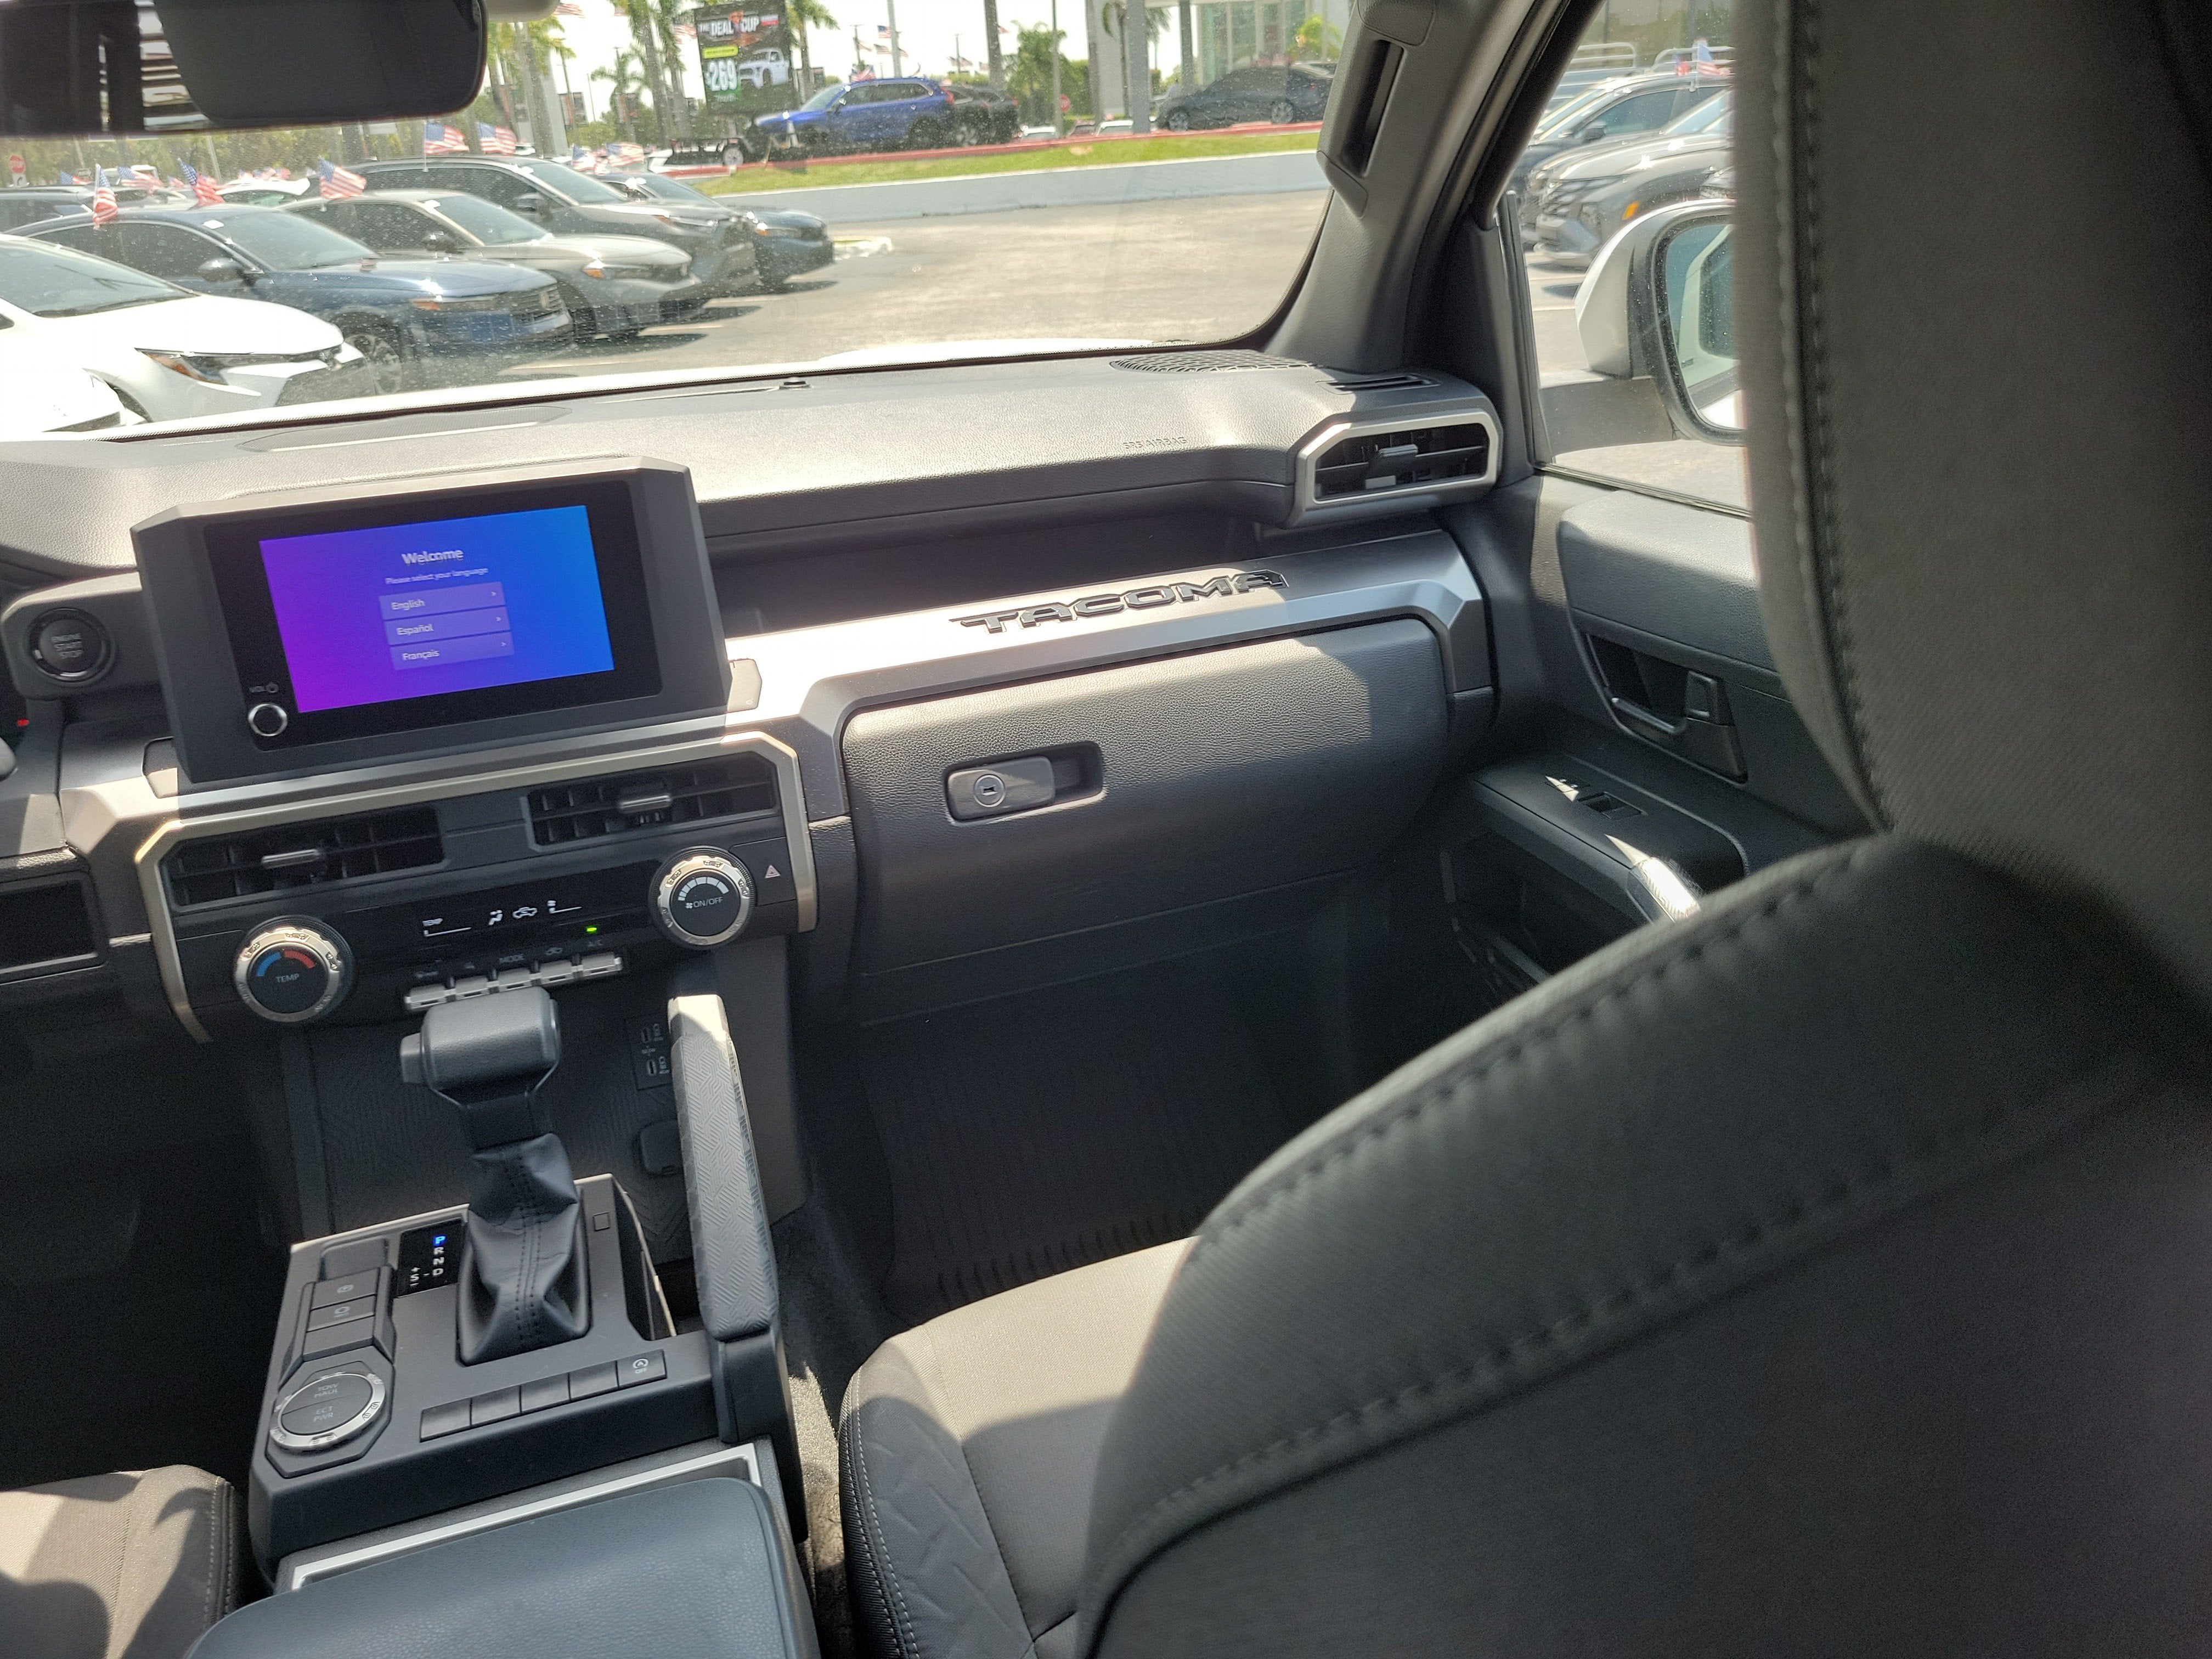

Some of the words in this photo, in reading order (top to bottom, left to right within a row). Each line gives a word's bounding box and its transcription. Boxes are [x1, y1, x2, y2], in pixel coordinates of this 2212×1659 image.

[710, 19, 735, 36] DEAL
[740, 15, 759, 32] CUP
[402, 550, 464, 565] Welcome
[411, 574, 434, 582] select
[434, 572, 451, 580] your
[452, 568, 488, 577] language
[391, 599, 425, 611] English
[948, 569, 1289, 634] TACOMA
[397, 623, 434, 635] Español
[402, 650, 440, 661] Français
[693, 896, 723, 908] ON/OFF
[498, 953, 524, 963] MODE
[276, 973, 300, 983] TEMP
[435, 1236, 446, 1244] P
[433, 1247, 444, 1255] R
[433, 1257, 444, 1265] N
[318, 1382, 340, 1391] TOW
[314, 1389, 338, 1398] HAUL
[316, 1406, 333, 1414] ECT
[313, 1412, 334, 1422] PWR
